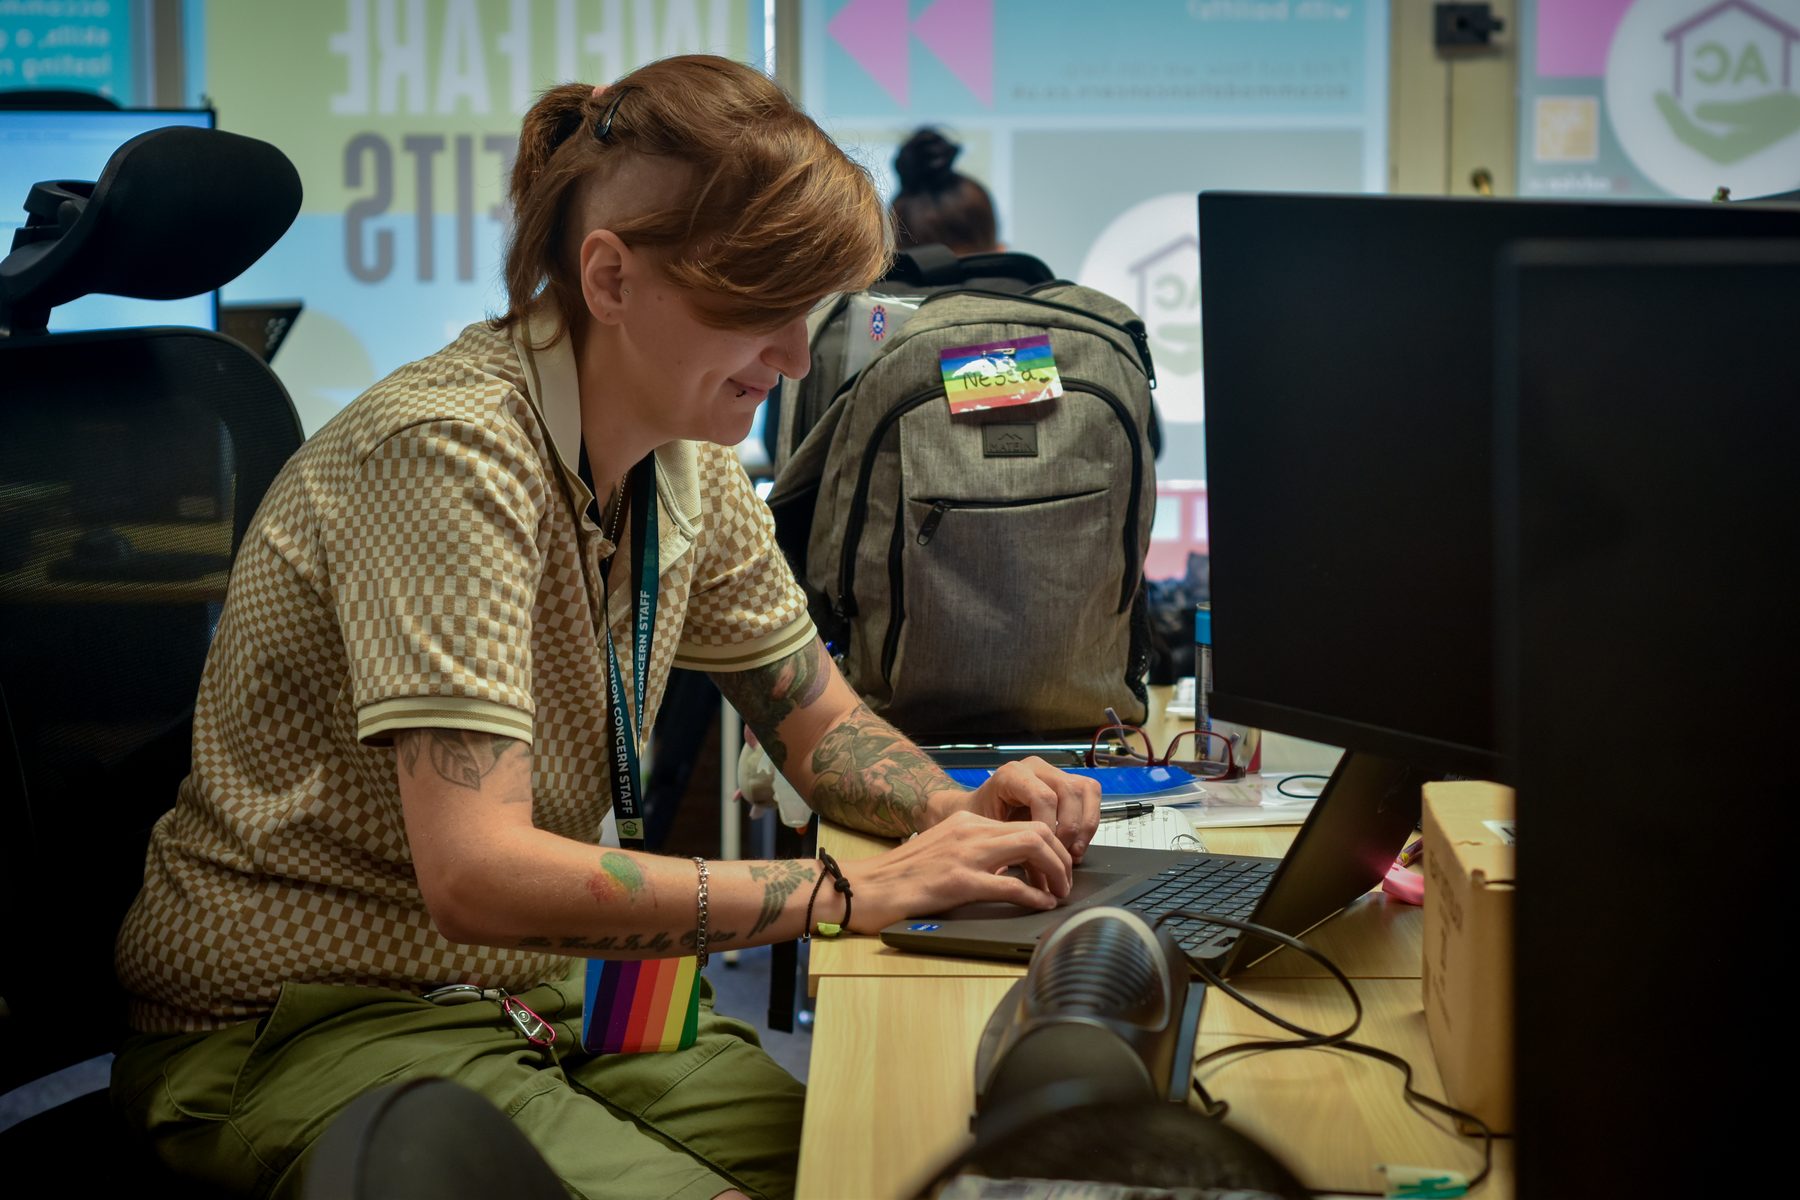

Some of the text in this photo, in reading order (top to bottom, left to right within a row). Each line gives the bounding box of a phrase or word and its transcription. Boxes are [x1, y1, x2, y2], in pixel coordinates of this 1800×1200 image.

[639, 590, 650, 631] STAFF
[638, 633, 648, 700] CONCERN
[613, 707, 629, 773] CONCERN
[619, 775, 634, 815] STAFF
